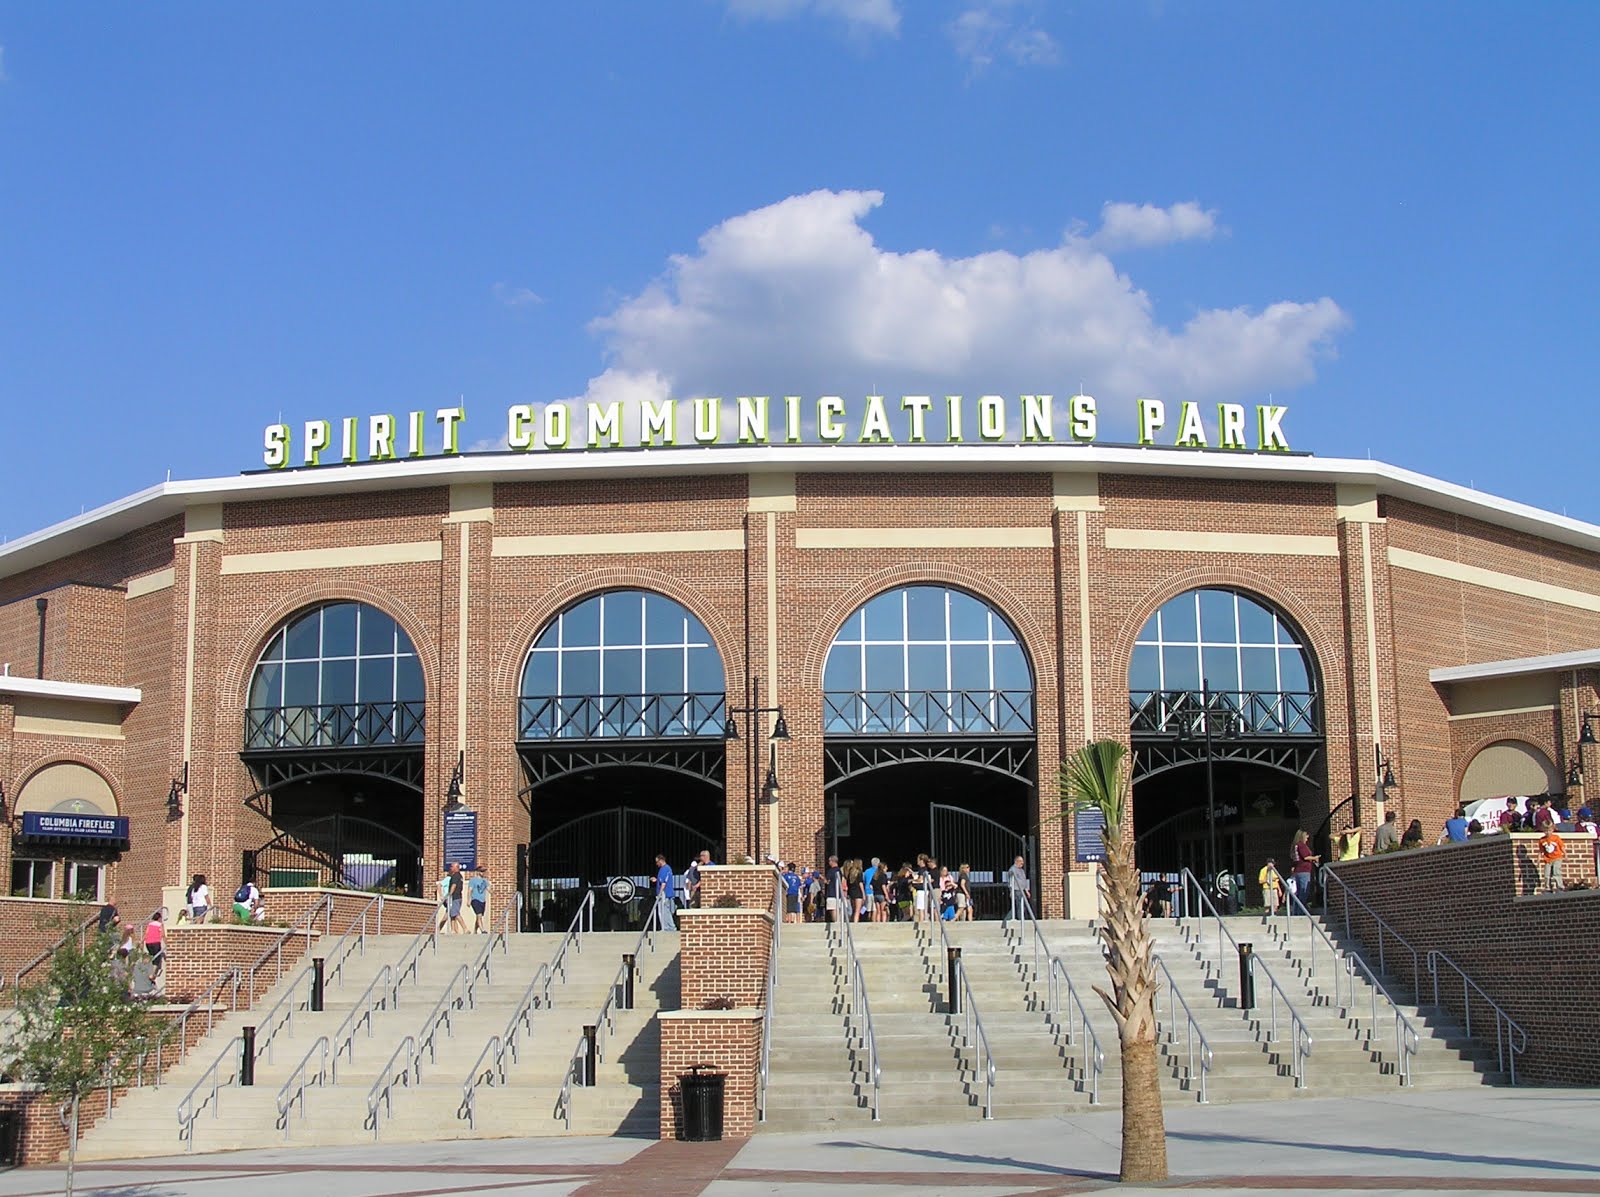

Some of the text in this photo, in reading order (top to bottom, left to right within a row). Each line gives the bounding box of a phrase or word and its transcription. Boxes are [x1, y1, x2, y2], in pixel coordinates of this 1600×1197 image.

[264, 395, 1290, 469] SPIRIT COMMUNICATIONS PARK
[39, 816, 115, 830] COLUMBIA FIREFLIES
